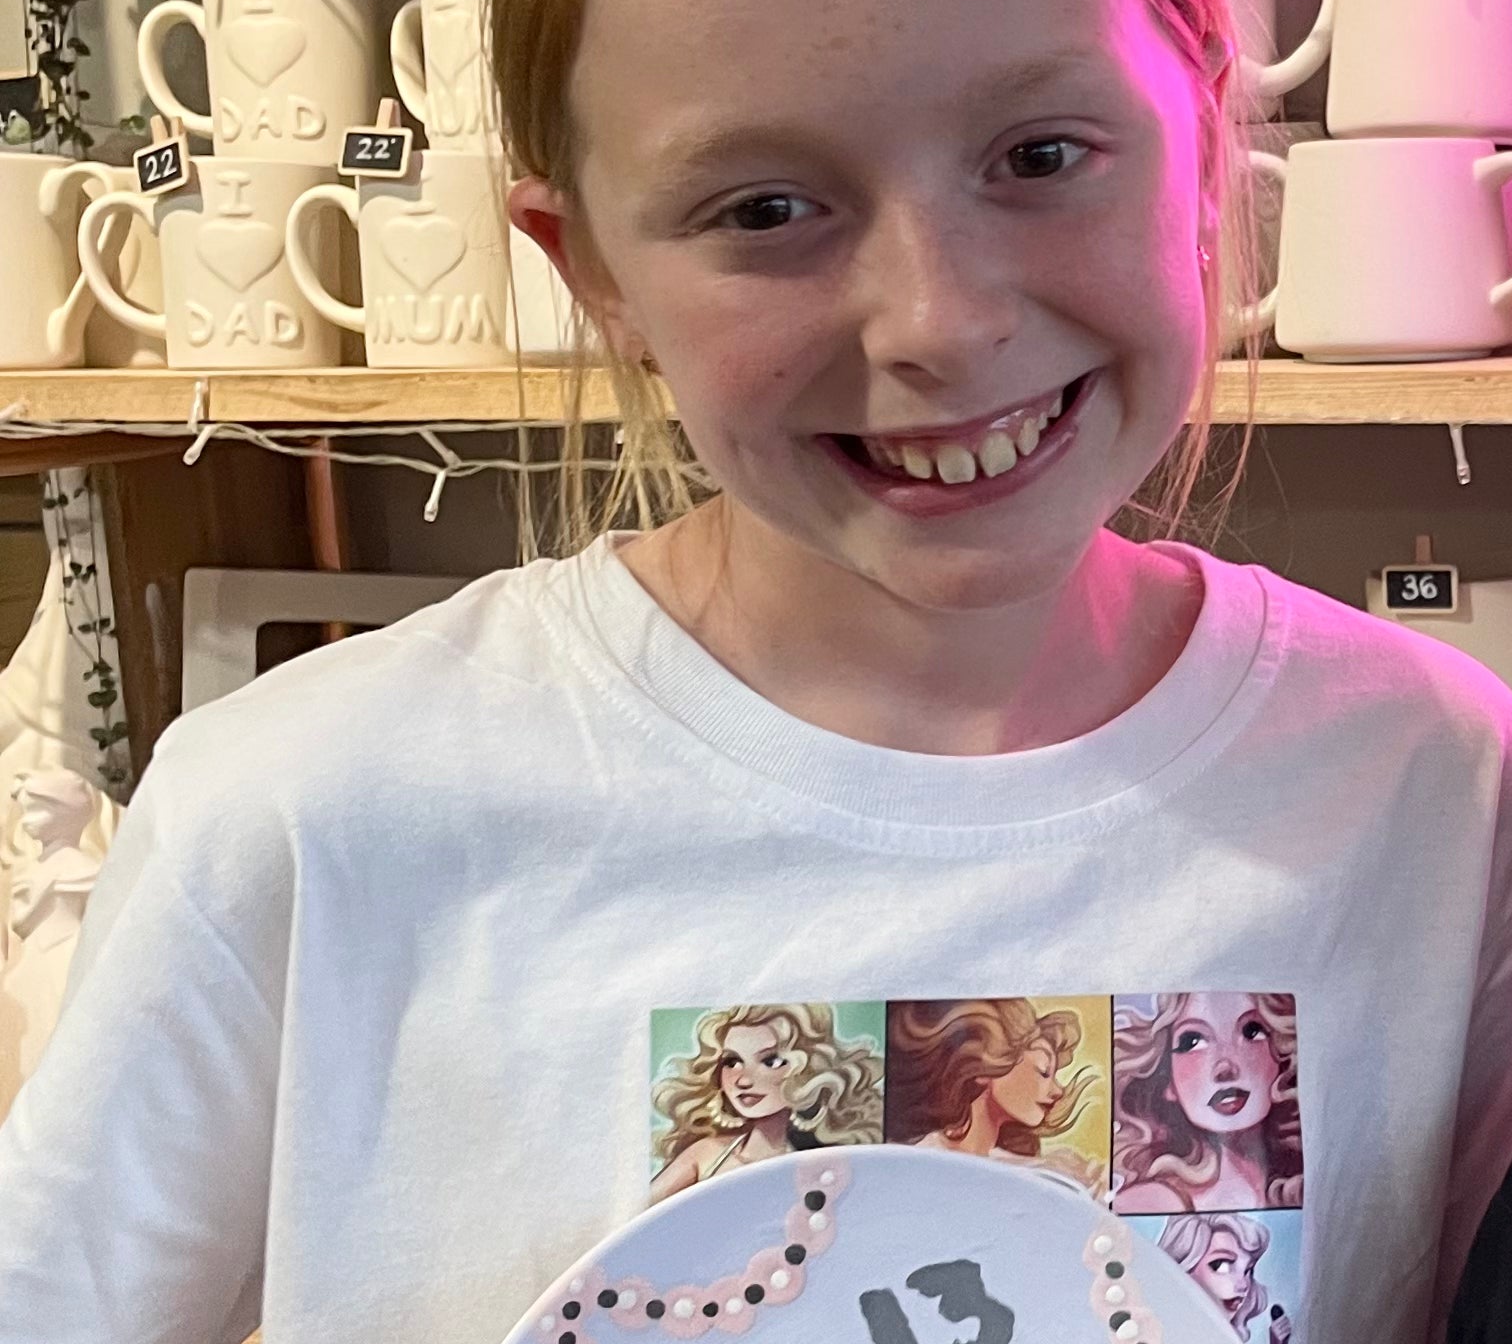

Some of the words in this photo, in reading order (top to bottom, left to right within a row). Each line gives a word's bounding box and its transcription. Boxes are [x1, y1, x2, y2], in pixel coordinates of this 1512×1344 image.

[218, 94, 327, 143] DAD
[145, 148, 178, 184] 22
[355, 137, 391, 160] 22
[186, 299, 305, 350] DAD
[371, 293, 501, 345] MUM
[1402, 574, 1438, 601] 36
